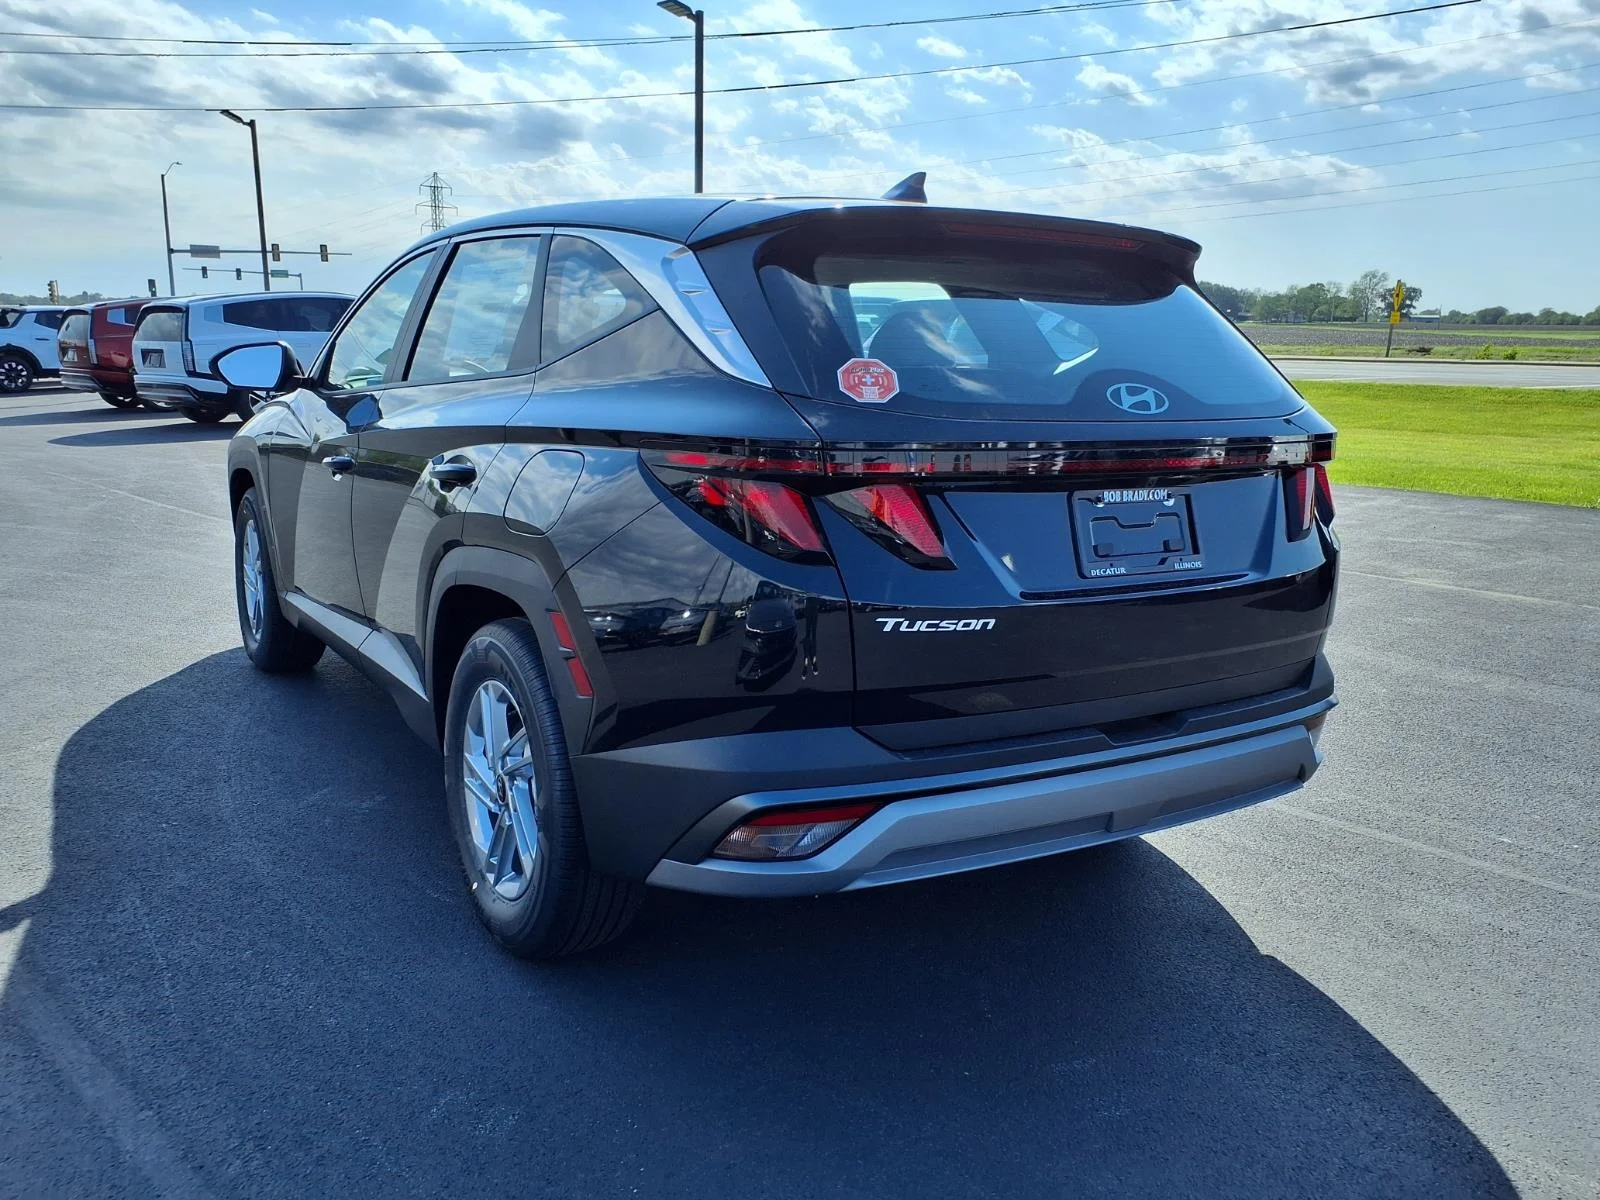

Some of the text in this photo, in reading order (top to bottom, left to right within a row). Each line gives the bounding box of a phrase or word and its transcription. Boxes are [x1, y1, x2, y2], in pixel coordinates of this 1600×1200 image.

[1103, 489, 1168, 502] BOB BRADY.COM
[1174, 561, 1202, 569] ILLINOIS
[1090, 567, 1126, 576] DECATUR
